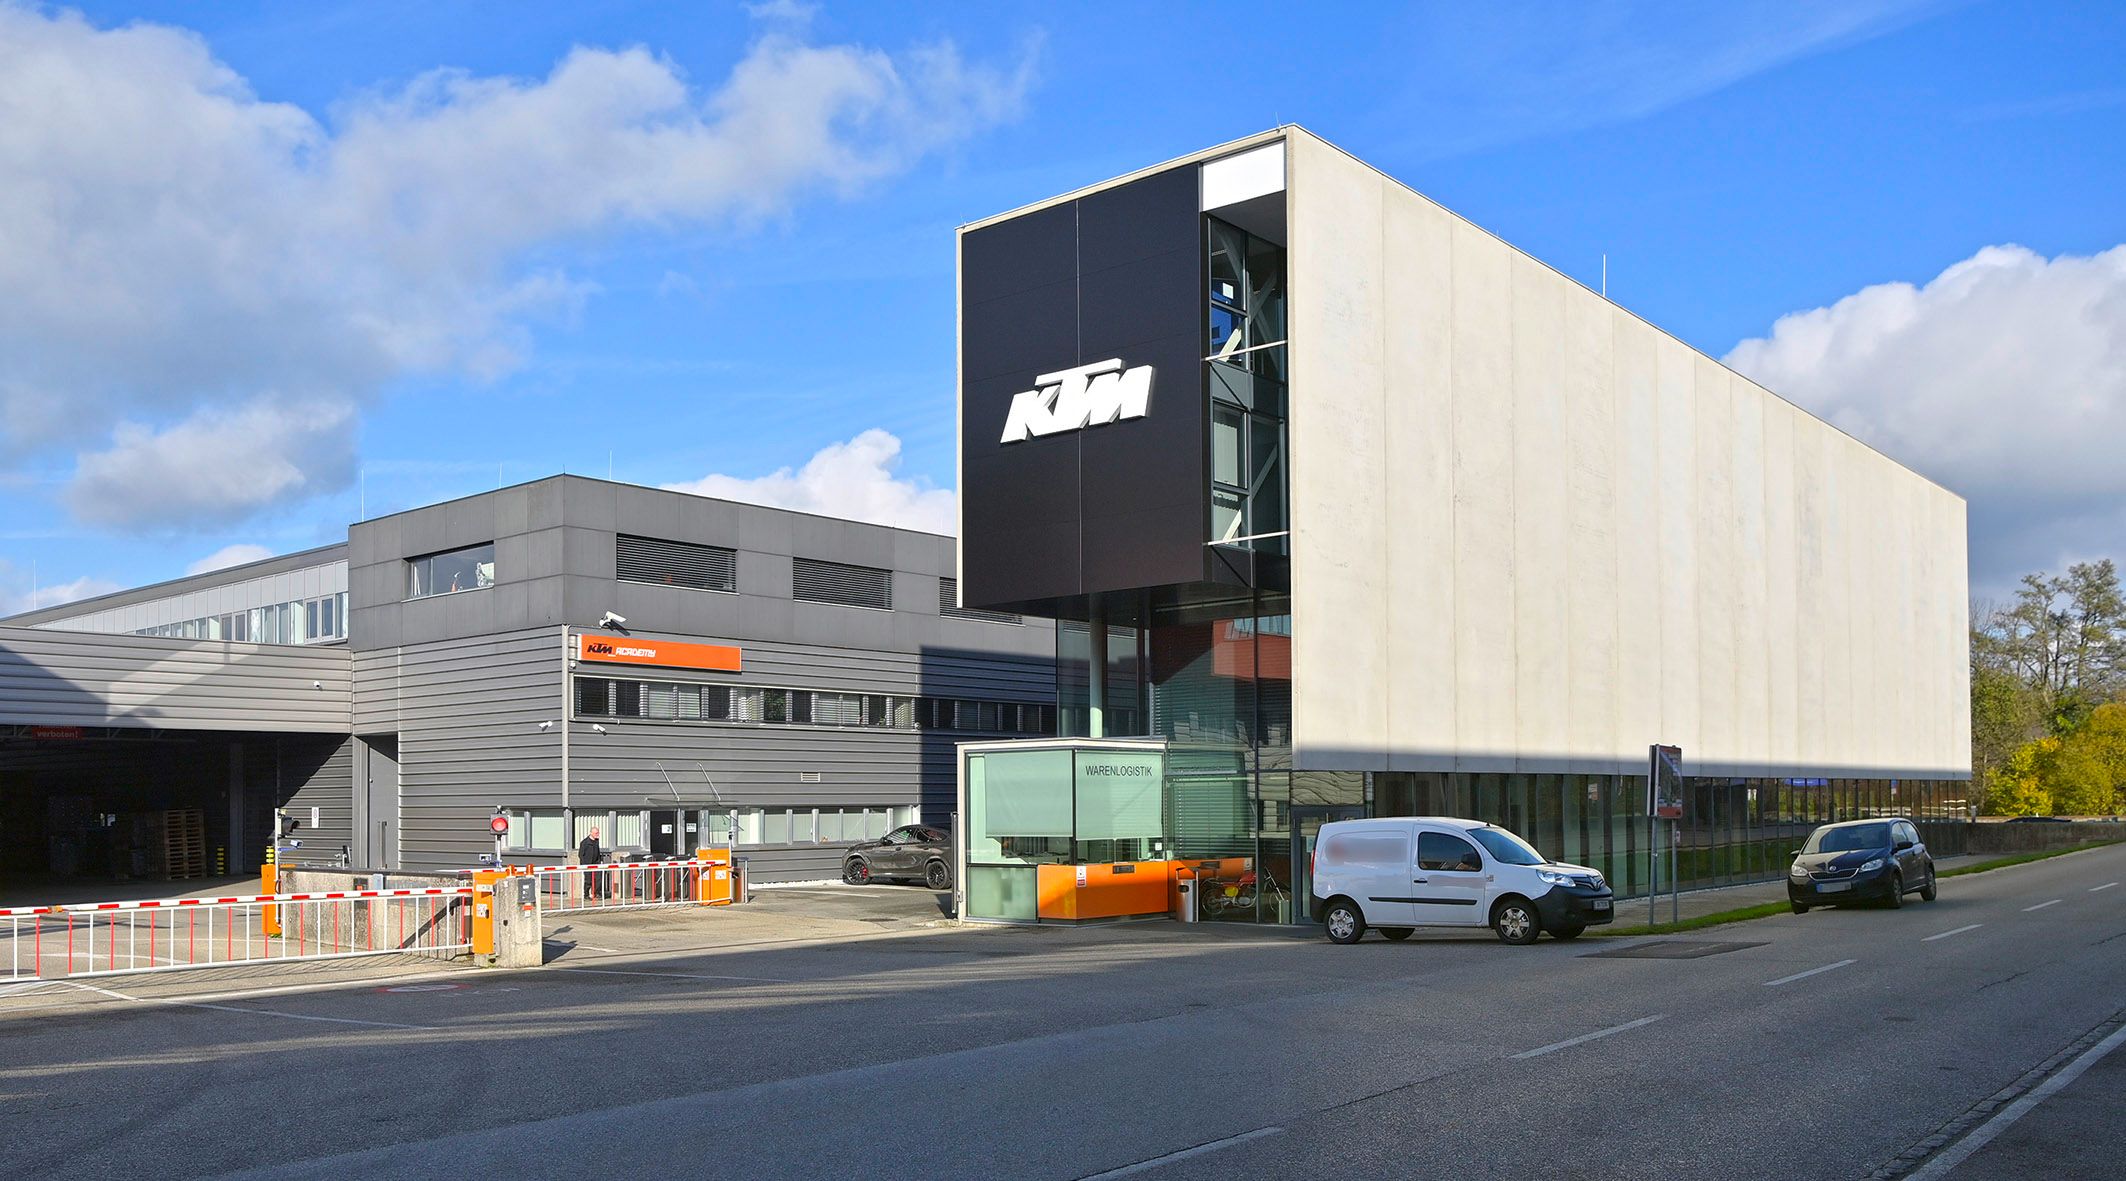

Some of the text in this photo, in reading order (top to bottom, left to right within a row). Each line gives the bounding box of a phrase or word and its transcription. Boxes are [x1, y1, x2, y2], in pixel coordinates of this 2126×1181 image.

[1000, 357, 1155, 443] KTM
[587, 643, 612, 654] KTM
[1085, 765, 1153, 777] WARENLOGISTIK
